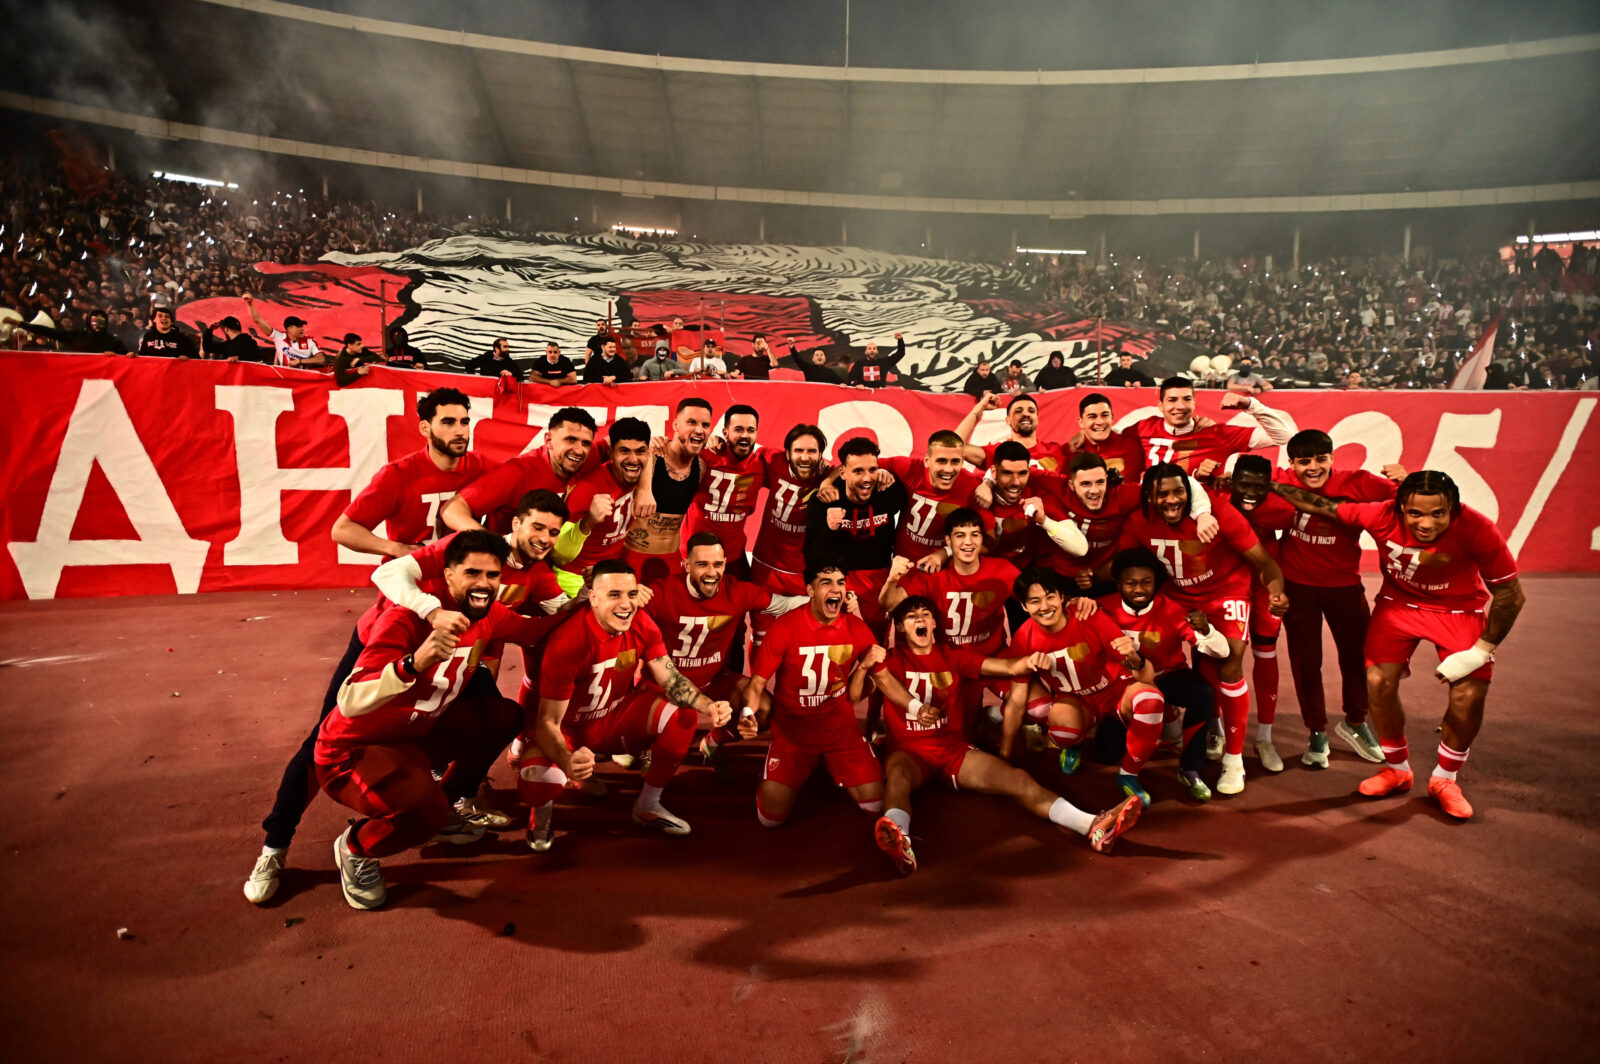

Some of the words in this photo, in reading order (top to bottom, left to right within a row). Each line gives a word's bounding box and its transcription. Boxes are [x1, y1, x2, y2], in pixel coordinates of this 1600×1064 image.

[605, 489, 635, 535] 37
[704, 469, 738, 513] 37
[772, 478, 801, 522] 37
[906, 493, 939, 536] 37
[1151, 538, 1183, 579] 37
[1386, 540, 1423, 580] 37
[945, 591, 974, 636] 37
[1223, 600, 1247, 622] 30
[673, 615, 710, 658] 37
[414, 646, 473, 713] 37
[577, 657, 618, 713] 37
[799, 645, 832, 696] 37
[1046, 647, 1082, 693] 37
[905, 671, 933, 721] 37
